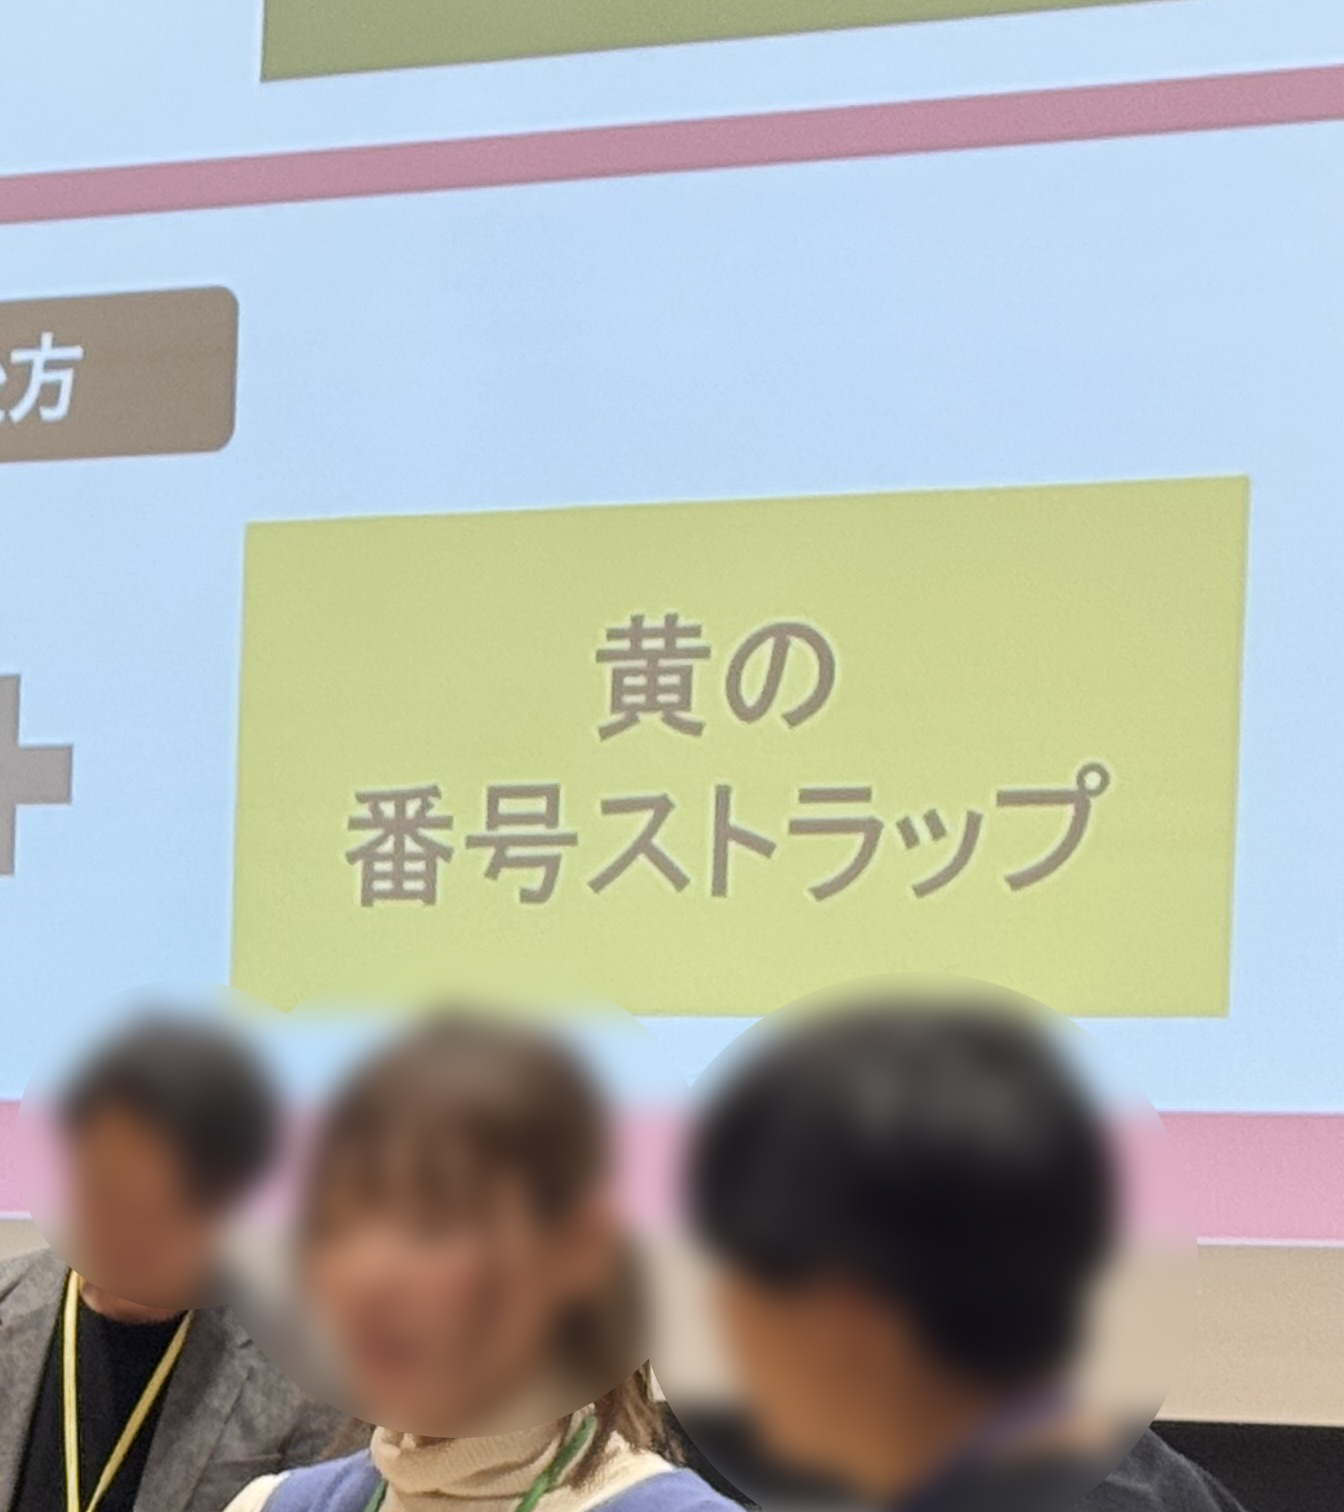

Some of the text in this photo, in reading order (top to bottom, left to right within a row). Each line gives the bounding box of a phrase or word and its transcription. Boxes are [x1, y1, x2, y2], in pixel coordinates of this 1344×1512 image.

[595, 613, 836, 740] 黄の
[345, 761, 1110, 907] 番号ストラップ
